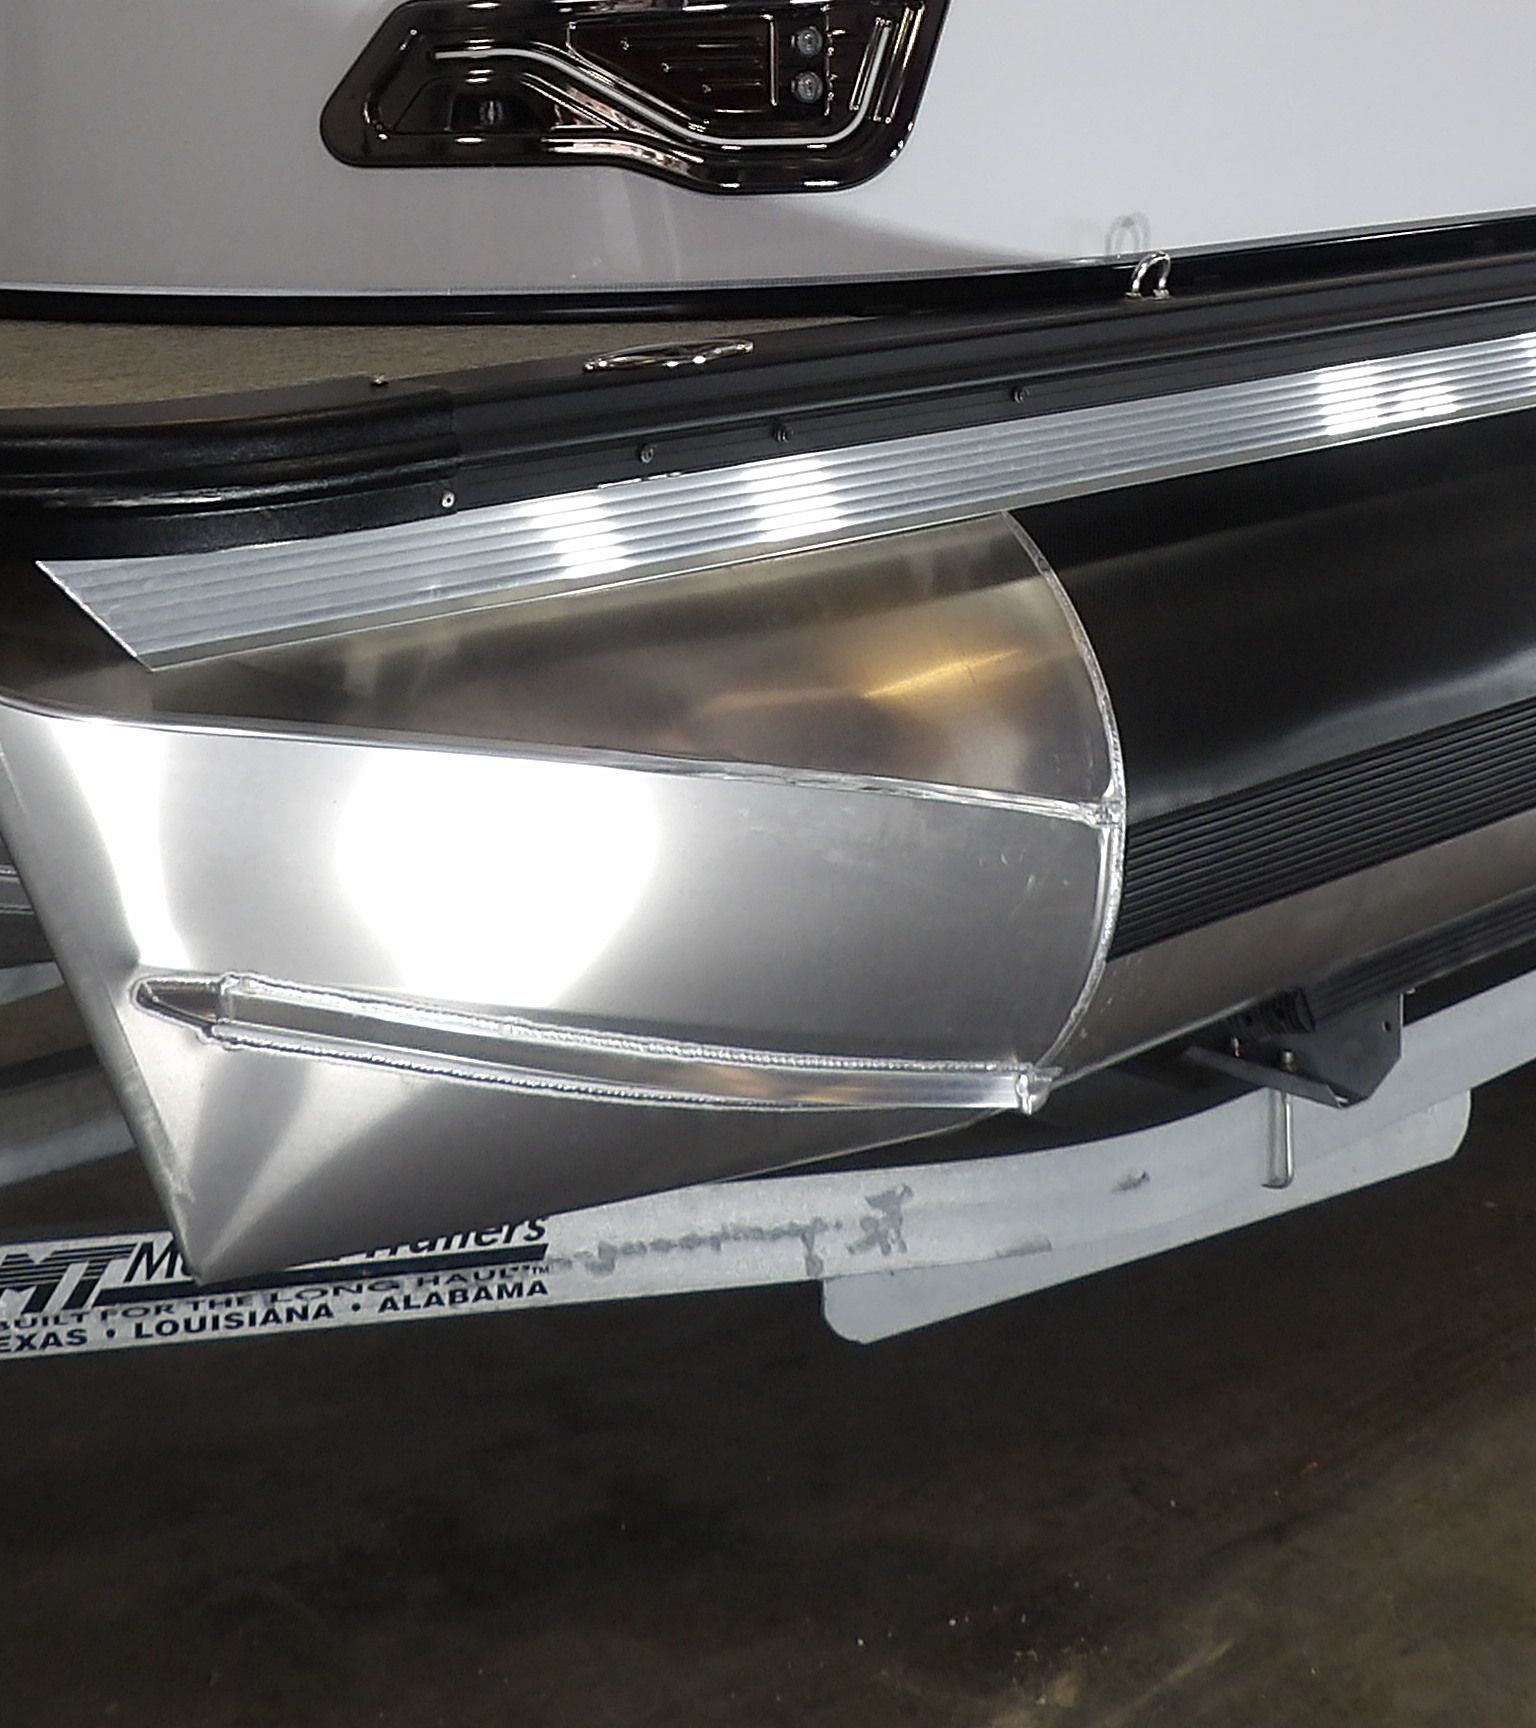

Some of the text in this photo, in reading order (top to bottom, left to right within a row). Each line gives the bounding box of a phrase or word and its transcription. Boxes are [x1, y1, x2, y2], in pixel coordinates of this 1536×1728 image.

[101, 1303, 175, 1322] FOR
[185, 1294, 255, 1313] THE
[269, 1281, 400, 1304] LONG
[134, 1302, 334, 1339] LOUISIANA
[378, 1279, 549, 1314] ALABAMA
